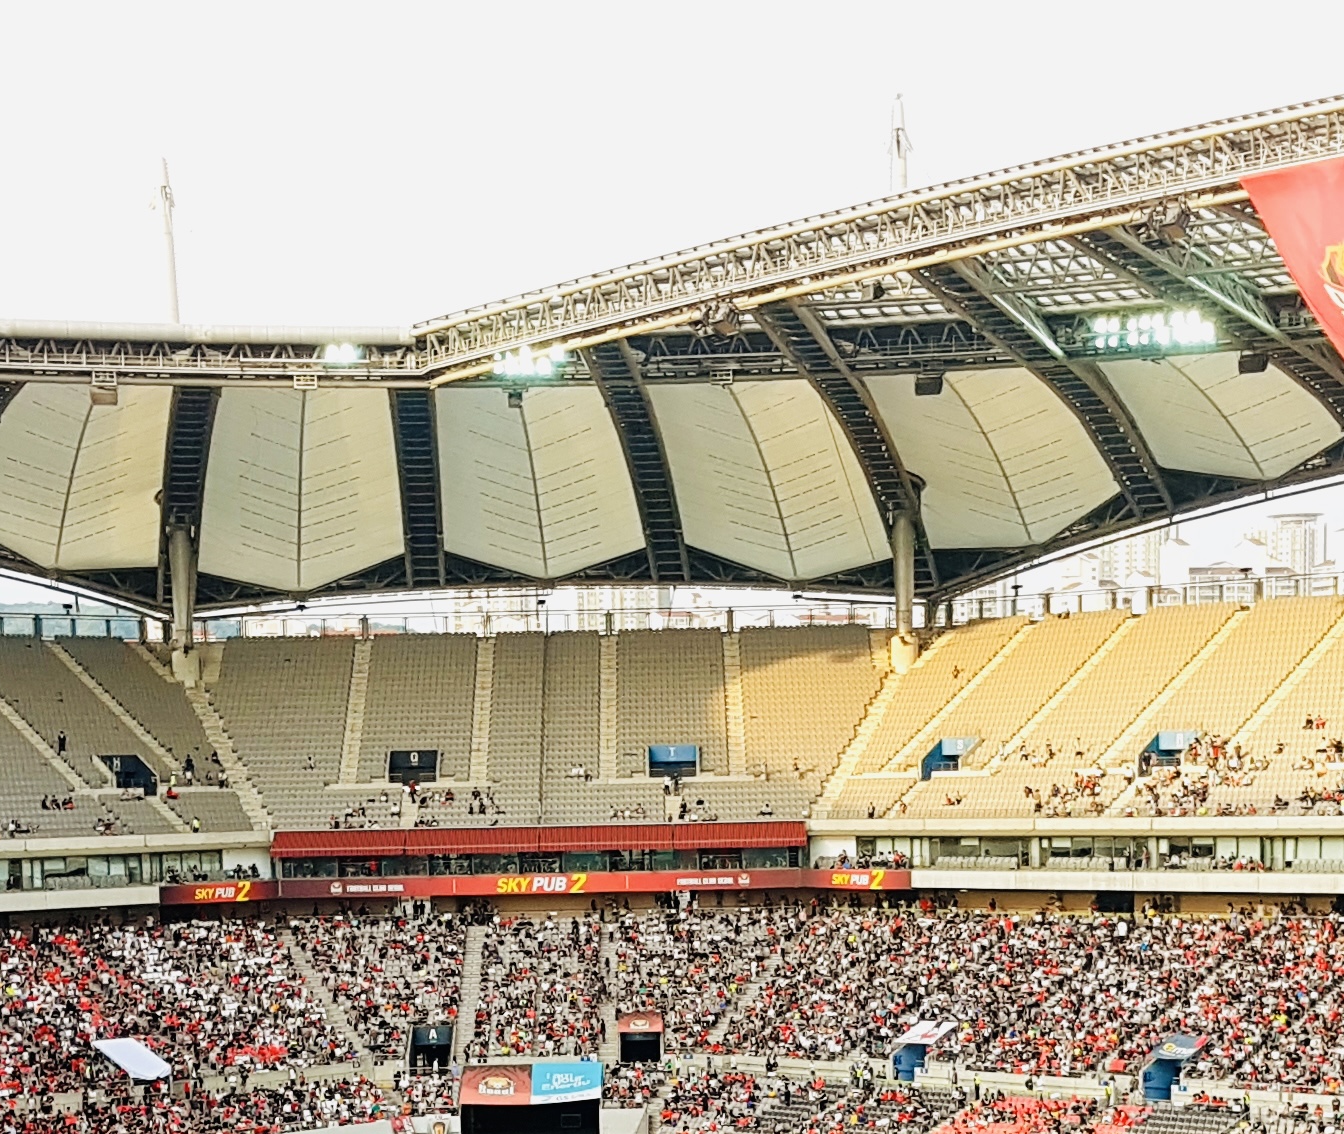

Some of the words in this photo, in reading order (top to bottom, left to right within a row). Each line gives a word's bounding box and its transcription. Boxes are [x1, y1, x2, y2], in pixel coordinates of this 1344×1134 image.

[497, 877, 530, 893] SKY
[532, 876, 566, 891] PUB
[569, 873, 587, 893] 2
[831, 873, 850, 885] SKY
[850, 874, 869, 885] PUB
[869, 870, 885, 890] 2
[195, 888, 215, 900] SKY
[215, 887, 235, 898] PUB
[236, 881, 251, 902] 2
